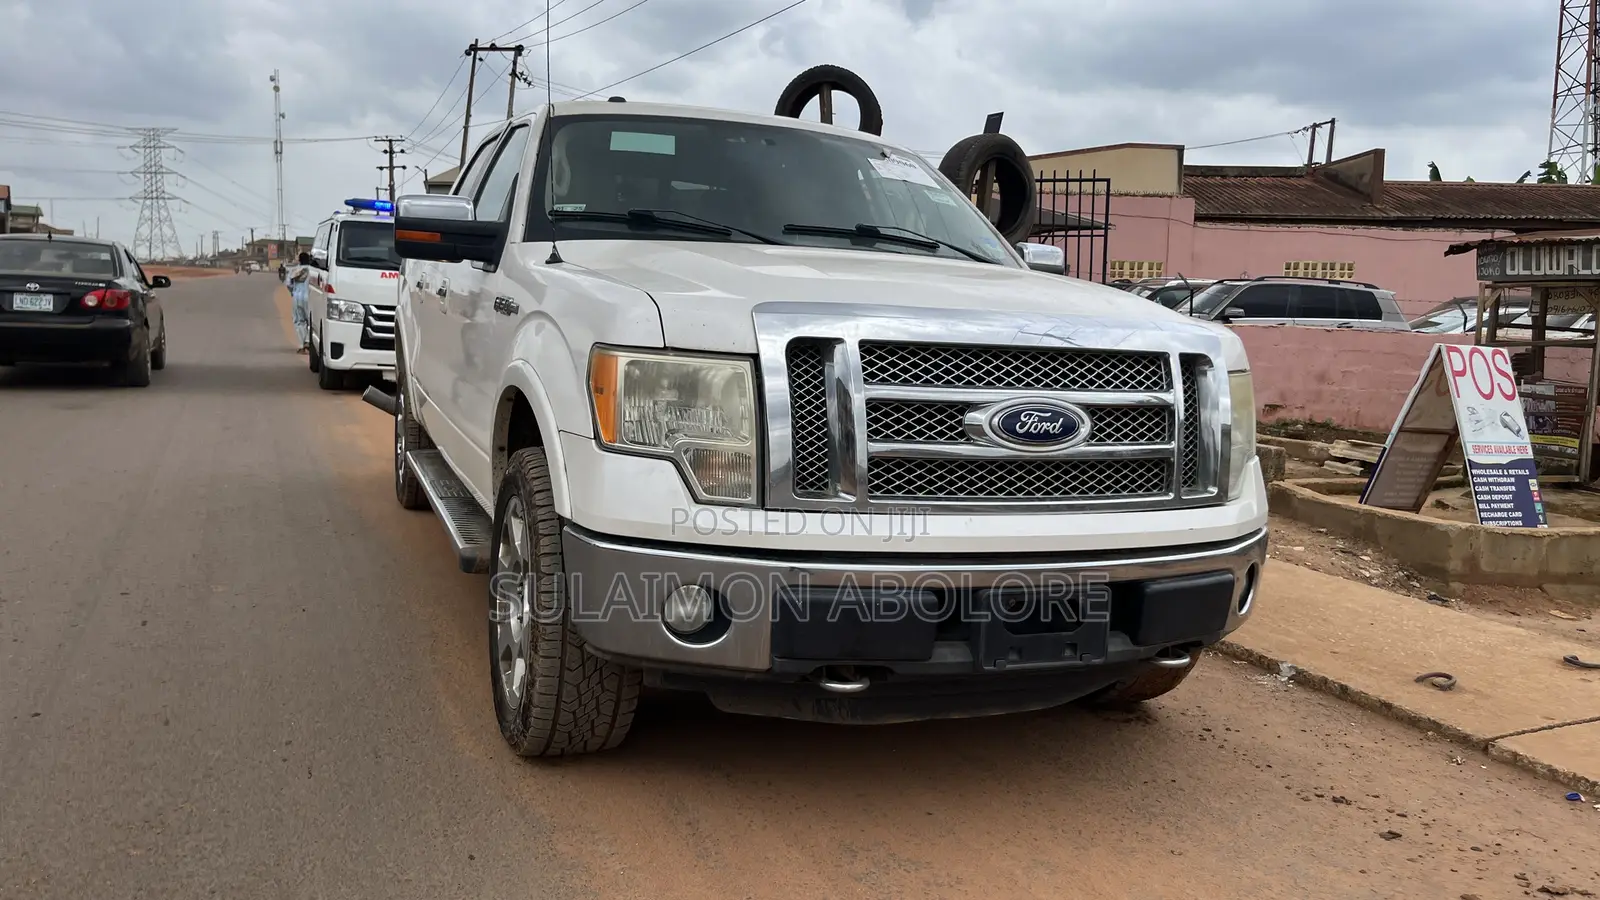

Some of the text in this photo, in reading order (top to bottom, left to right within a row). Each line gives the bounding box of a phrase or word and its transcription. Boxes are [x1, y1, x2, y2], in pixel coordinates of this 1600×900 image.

[1446, 345, 1517, 401] POS
[1015, 410, 1064, 434] Ford
[1471, 444, 1494, 454] SERVICES
[1494, 445, 1517, 454] AVAILABLE
[1517, 445, 1529, 455] HERE
